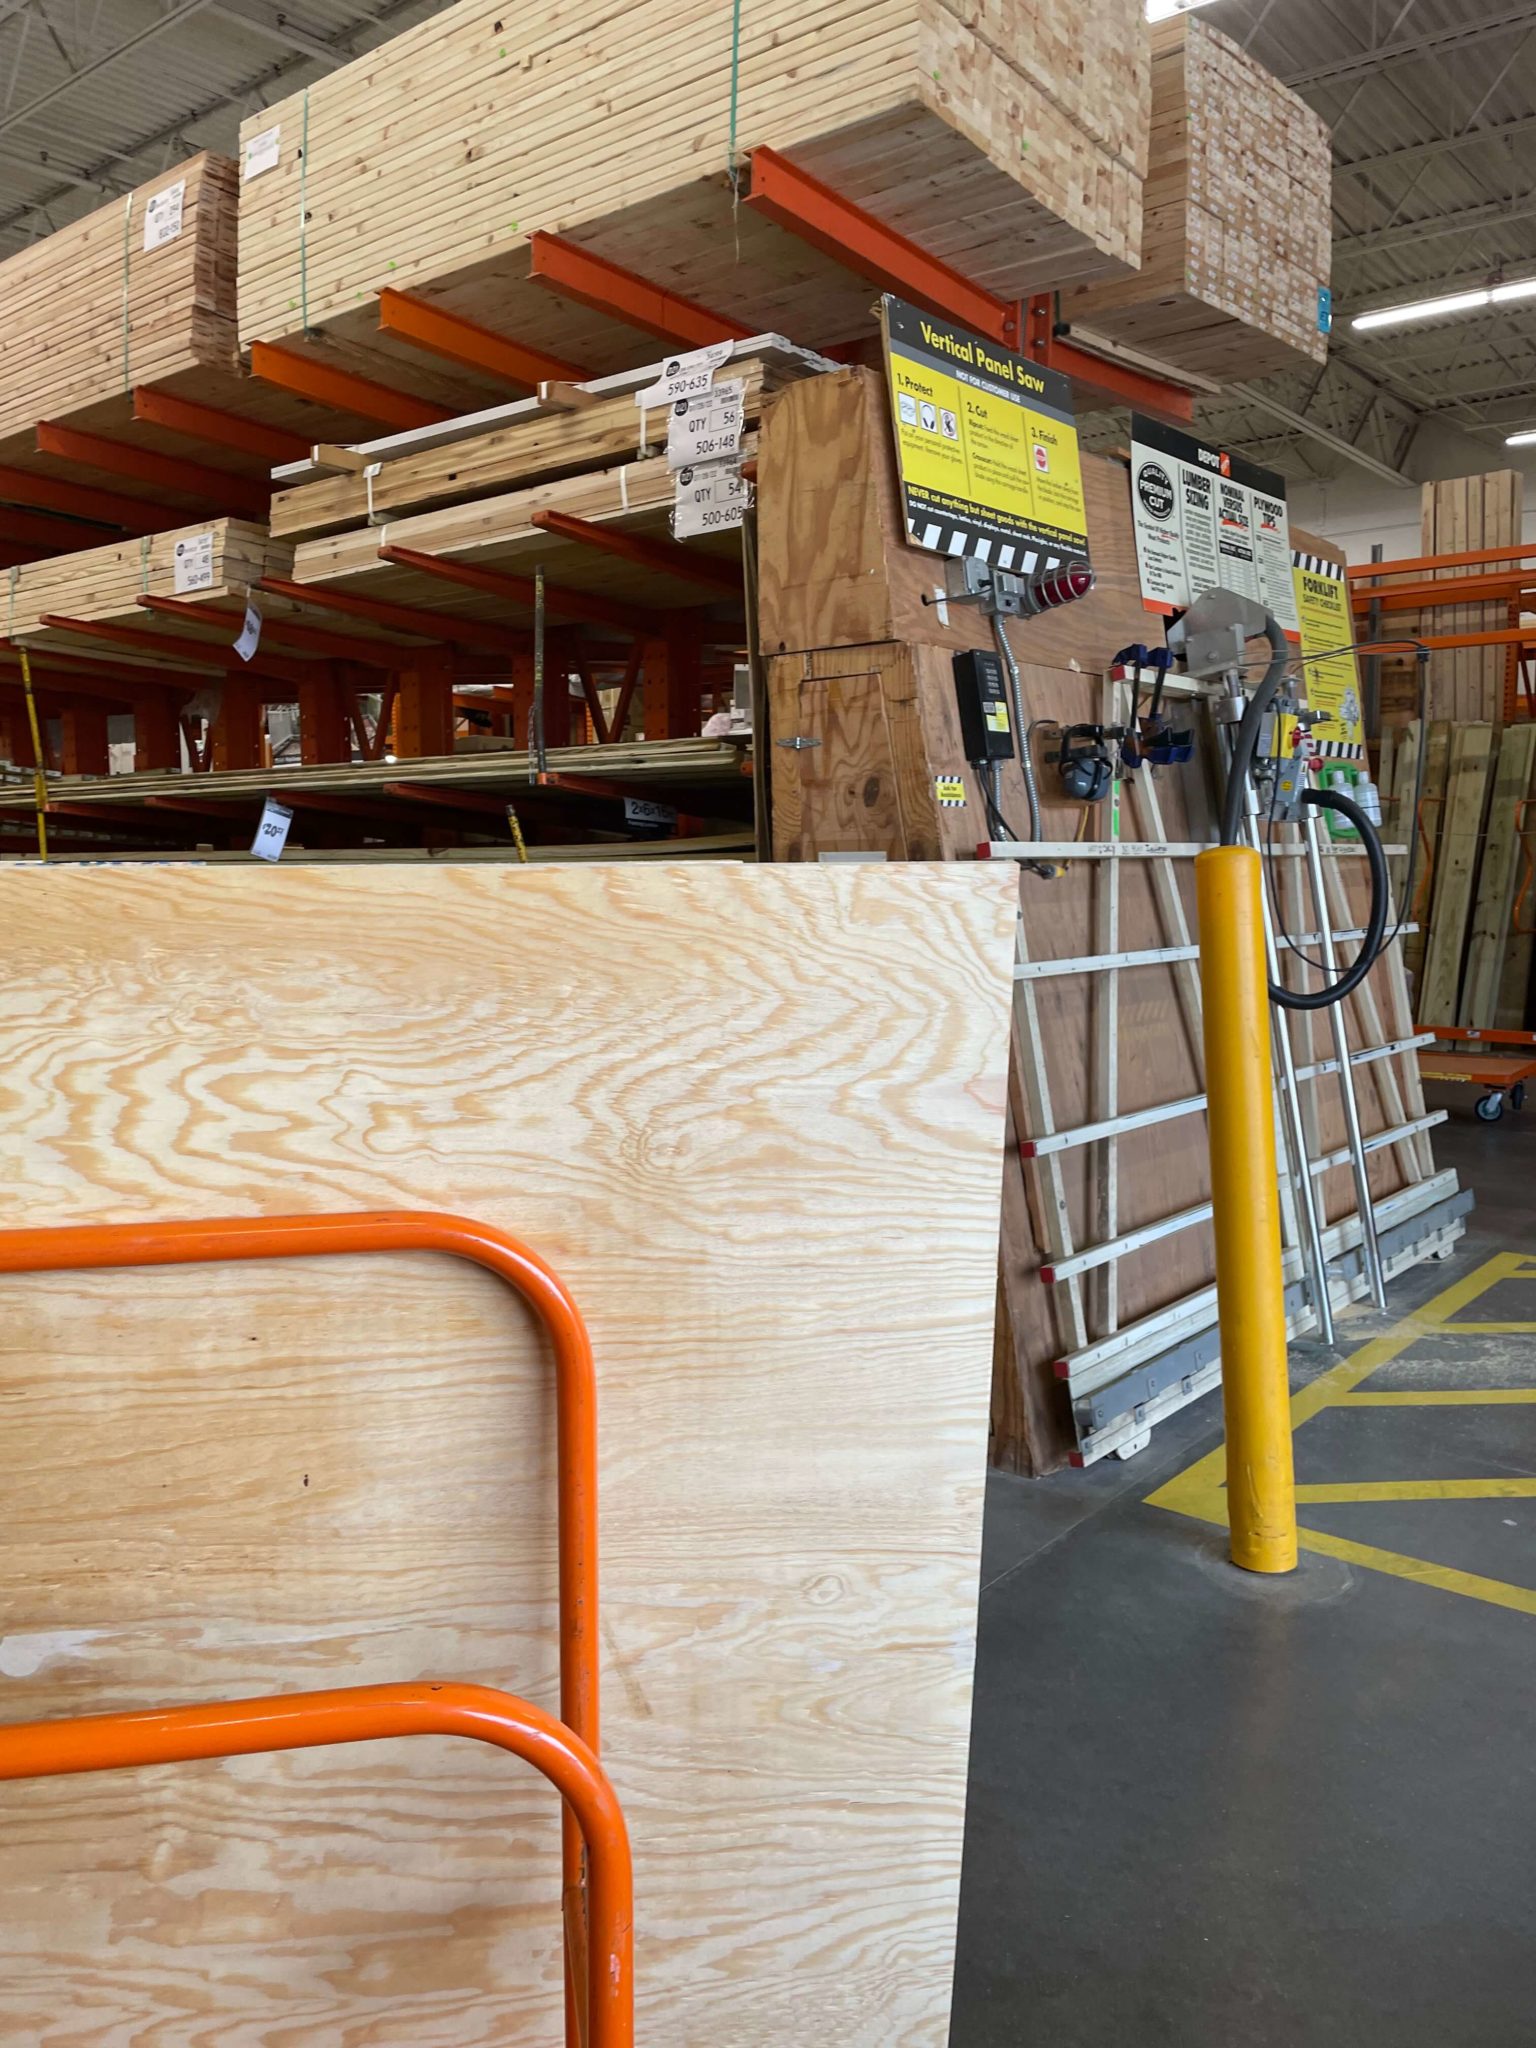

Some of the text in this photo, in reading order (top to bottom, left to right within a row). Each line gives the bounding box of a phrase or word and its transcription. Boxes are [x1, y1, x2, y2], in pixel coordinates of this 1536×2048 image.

[920, 321, 1045, 393] Vertical Panel Saw
[668, 373, 708, 396] 590-635
[897, 373, 933, 397] 1. Protect
[955, 370, 968, 382] NOT
[969, 375, 980, 387] FOR
[689, 411, 735, 432] QTY 56
[976, 405, 988, 419] Cut
[696, 434, 735, 455] 506-148
[1039, 430, 1058, 446] Finish
[1198, 448, 1220, 468] DEPOT
[1140, 479, 1173, 500] PREMIUM
[1182, 469, 1211, 494] LUMBER
[695, 488, 711, 502] QTY
[908, 485, 930, 500] NEVER
[1149, 496, 1164, 509] CUT
[1186, 488, 1209, 510] SIZING
[1220, 483, 1244, 502] NOMINAL
[1223, 496, 1243, 513] VERSUS
[1253, 496, 1283, 517] PLYWOOD
[702, 506, 743, 526] 500-605
[1263, 512, 1276, 528] TIPS
[1303, 576, 1338, 600] FORKLIFT
